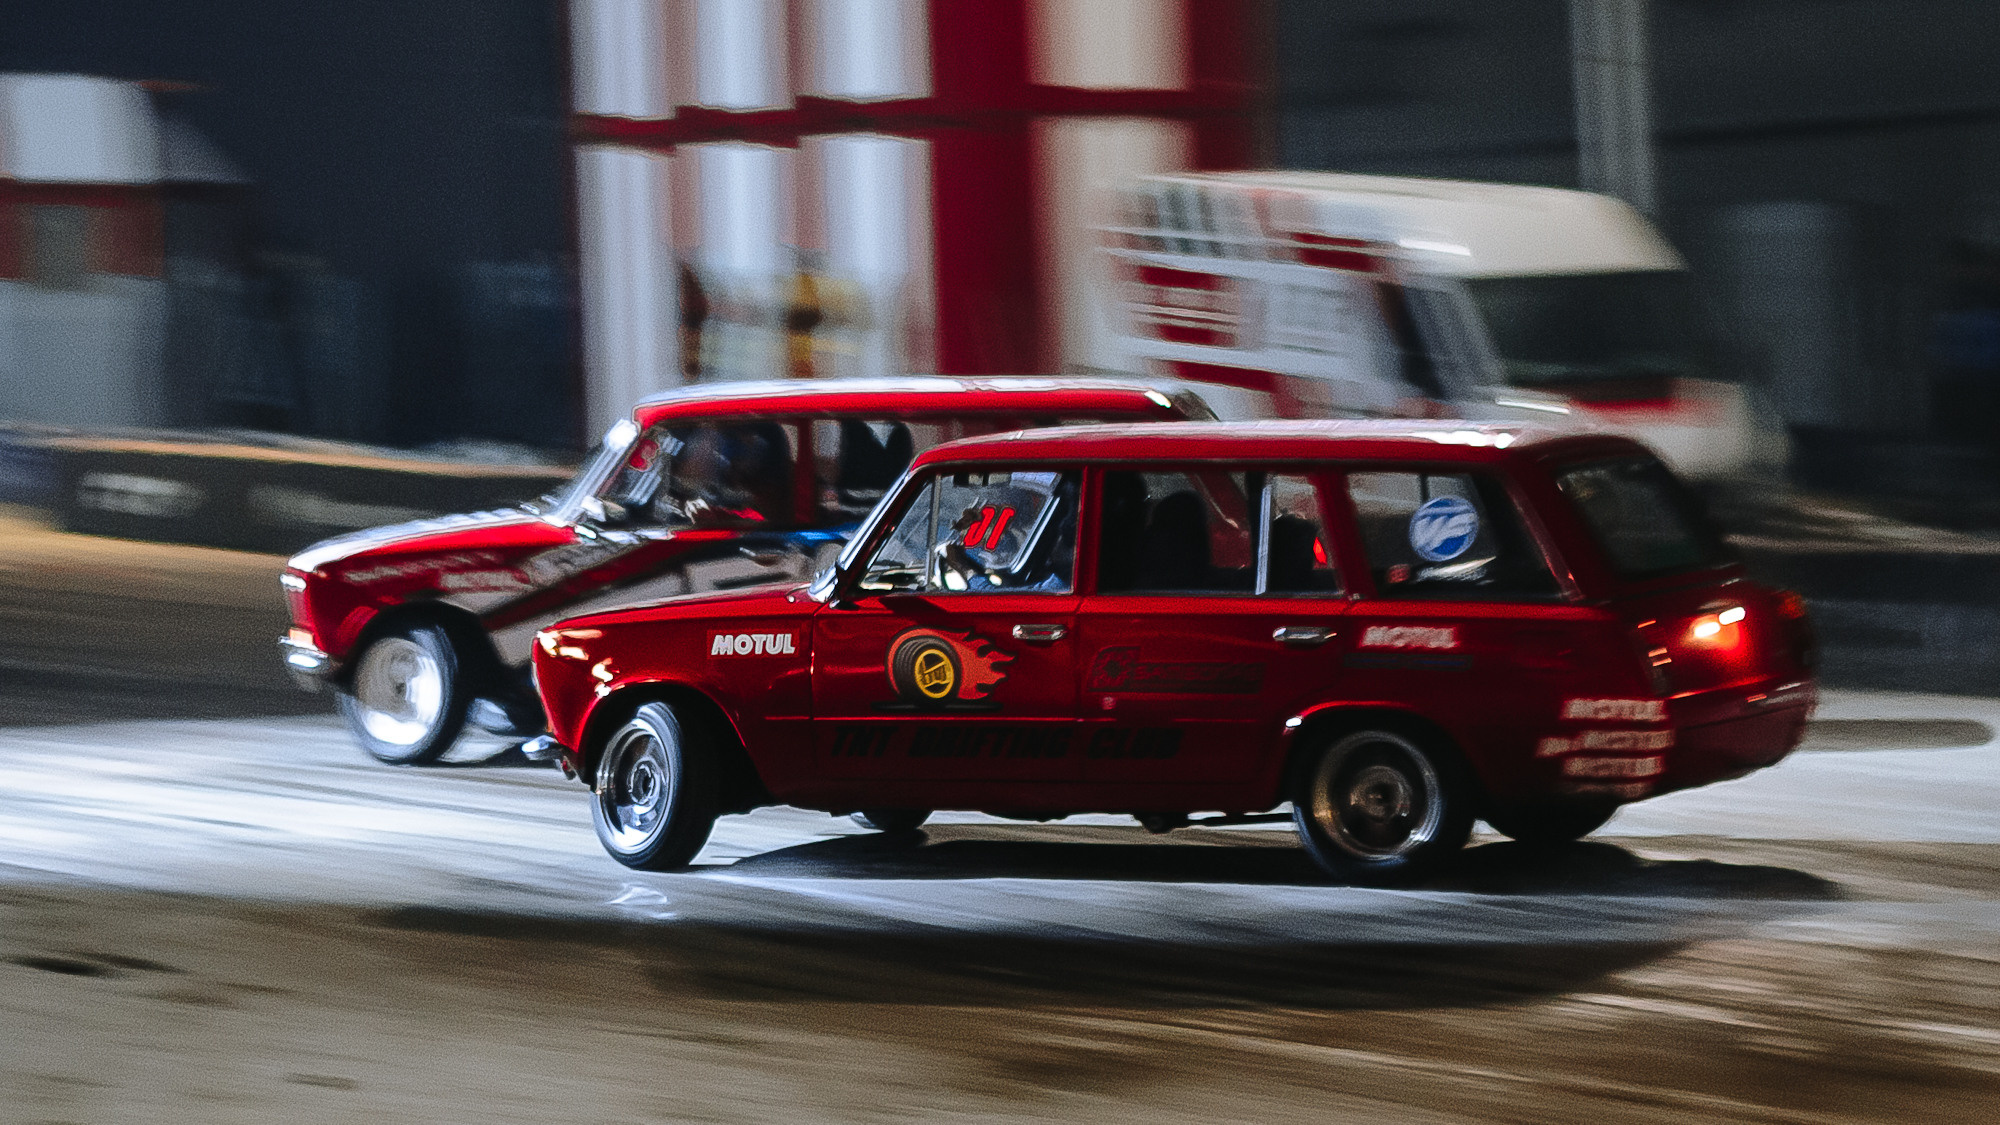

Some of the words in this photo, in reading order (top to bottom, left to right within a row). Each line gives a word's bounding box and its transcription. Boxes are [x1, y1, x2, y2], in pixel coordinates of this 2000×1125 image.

[711, 633, 795, 656] MOTUL
[830, 725, 899, 758] TNT
[907, 726, 1072, 759] DRIFTING
[1086, 727, 1184, 760] CLUB
